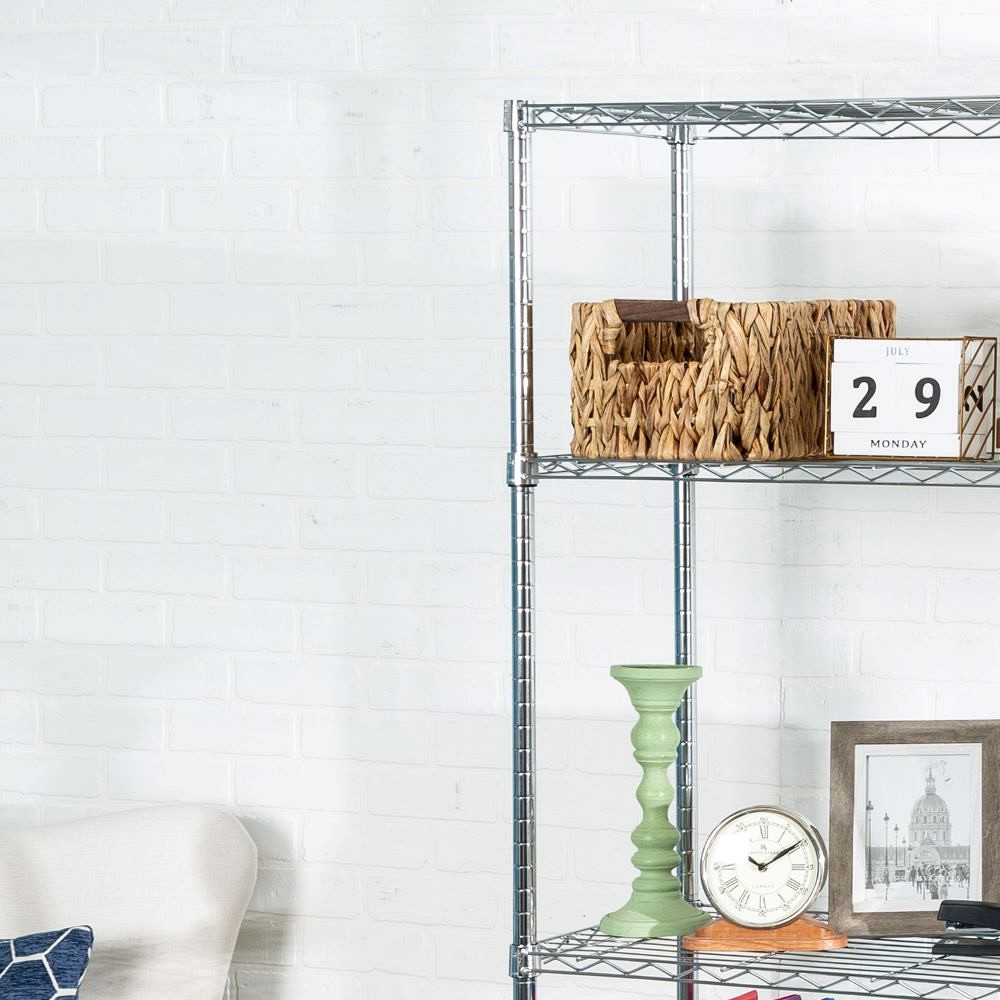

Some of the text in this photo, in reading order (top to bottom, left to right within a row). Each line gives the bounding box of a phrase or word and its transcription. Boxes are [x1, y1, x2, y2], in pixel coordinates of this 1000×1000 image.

[886, 346, 911, 357] JULY
[852, 376, 941, 419] 2 9
[870, 439, 927, 449] MONDAY
